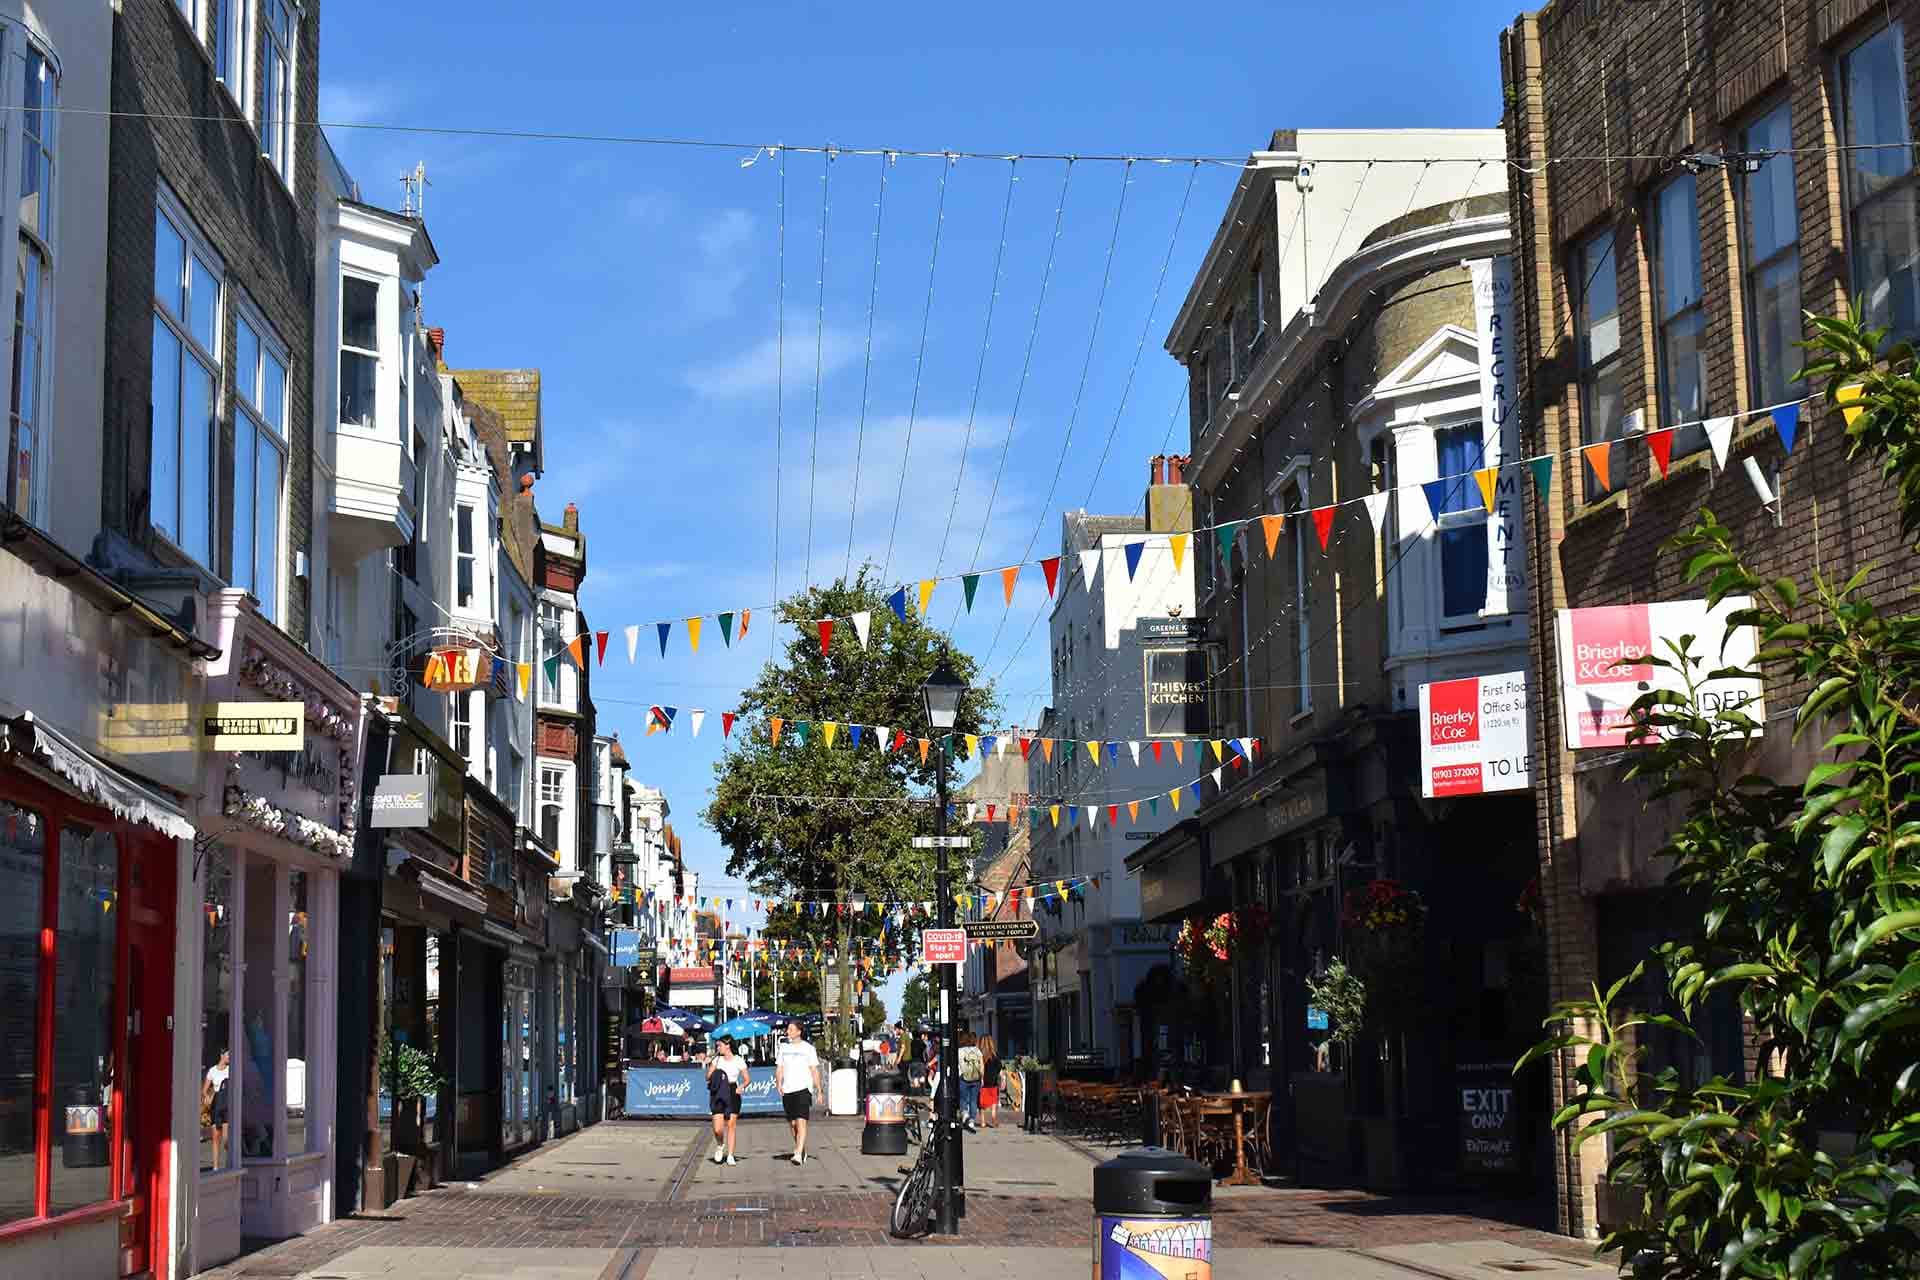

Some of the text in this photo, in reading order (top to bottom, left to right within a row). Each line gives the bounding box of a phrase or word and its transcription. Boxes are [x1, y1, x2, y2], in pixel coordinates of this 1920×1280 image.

[1149, 624, 1182, 632] GREENE
[1577, 640, 1647, 660] Brierley
[1482, 681, 1528, 696] First Floo
[1151, 694, 1204, 704] KITCHEN
[1482, 700, 1511, 714] Office
[207, 719, 258, 727] WESTERN
[1432, 708, 1475, 726] Brierley
[223, 726, 258, 734] UNION
[1488, 755, 1536, 776] TO LE
[1433, 769, 1452, 780] 01903
[926, 932, 963, 940] COVID-19
[929, 943, 960, 952] Stay 2m
[935, 952, 955, 960] apart
[644, 1079, 690, 1097] Jonny's
[1464, 1089, 1512, 1112] EXIT
[1472, 1114, 1504, 1128] ONLY
